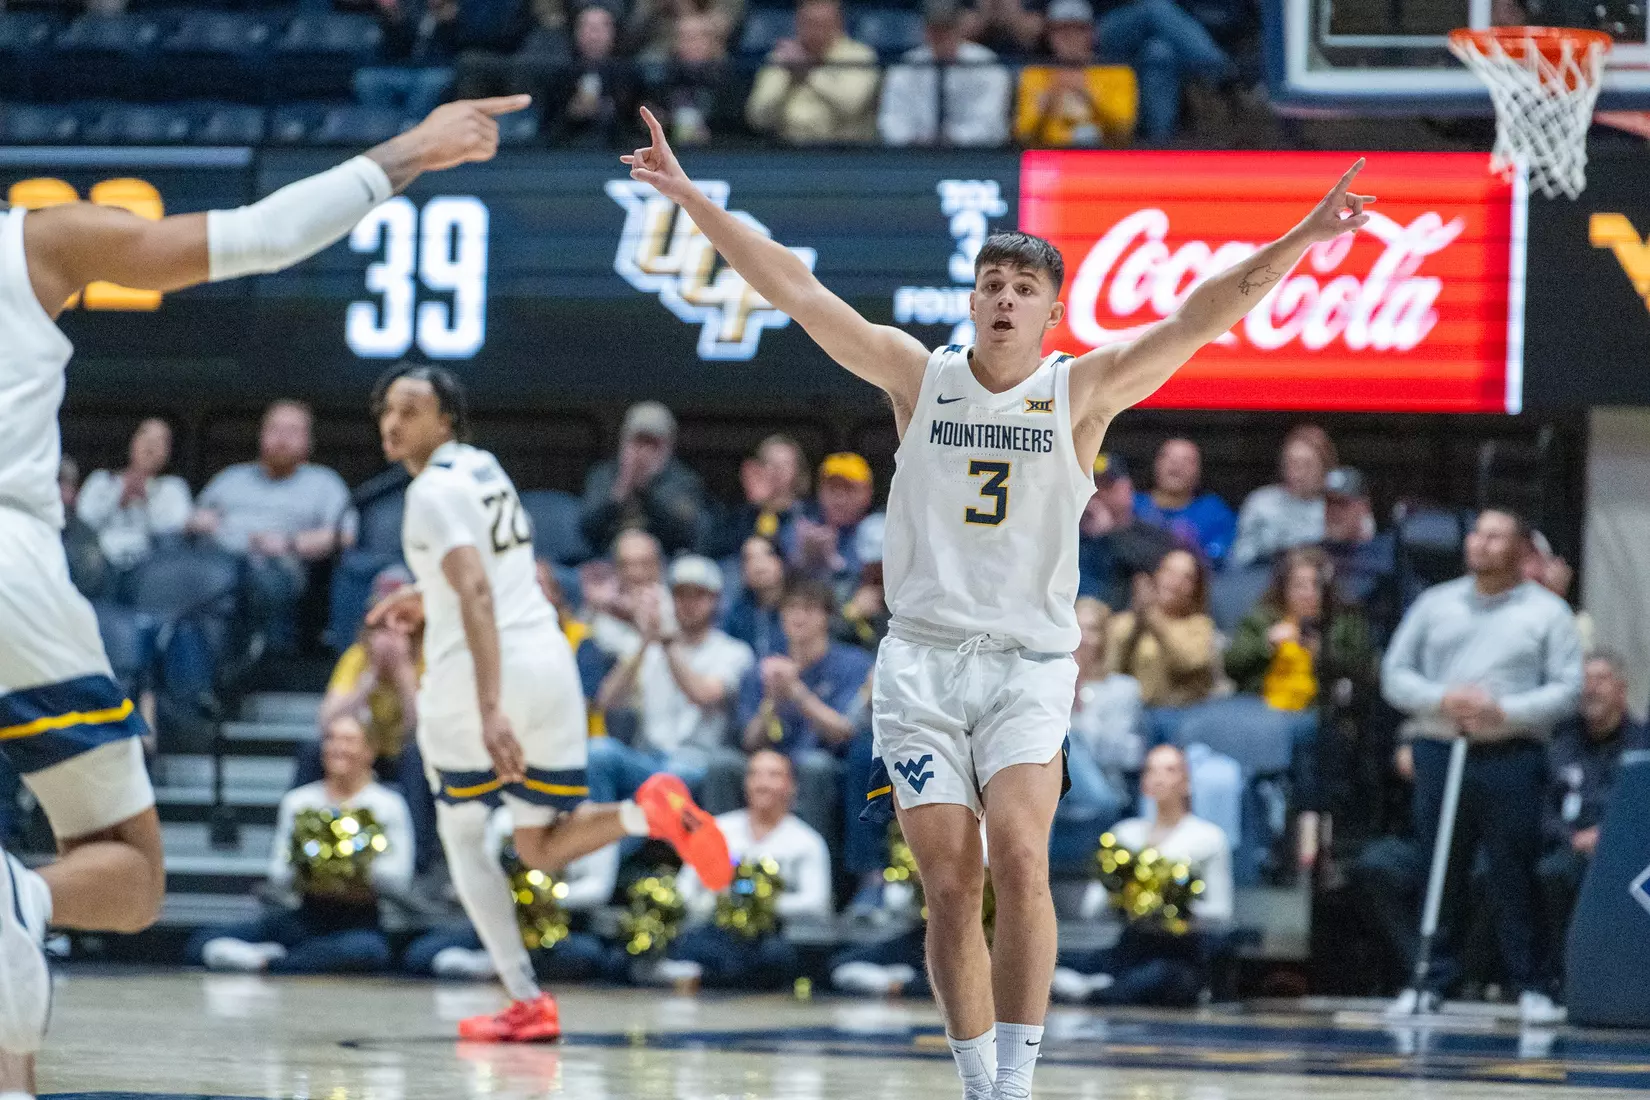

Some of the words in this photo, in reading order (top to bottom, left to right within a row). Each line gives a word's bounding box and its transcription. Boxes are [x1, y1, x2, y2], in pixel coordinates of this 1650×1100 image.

[345, 196, 490, 359] 39
[1068, 208, 1467, 351] CocCola
[929, 419, 1054, 453] MOUNTAINEERS
[964, 459, 1012, 527] 3
